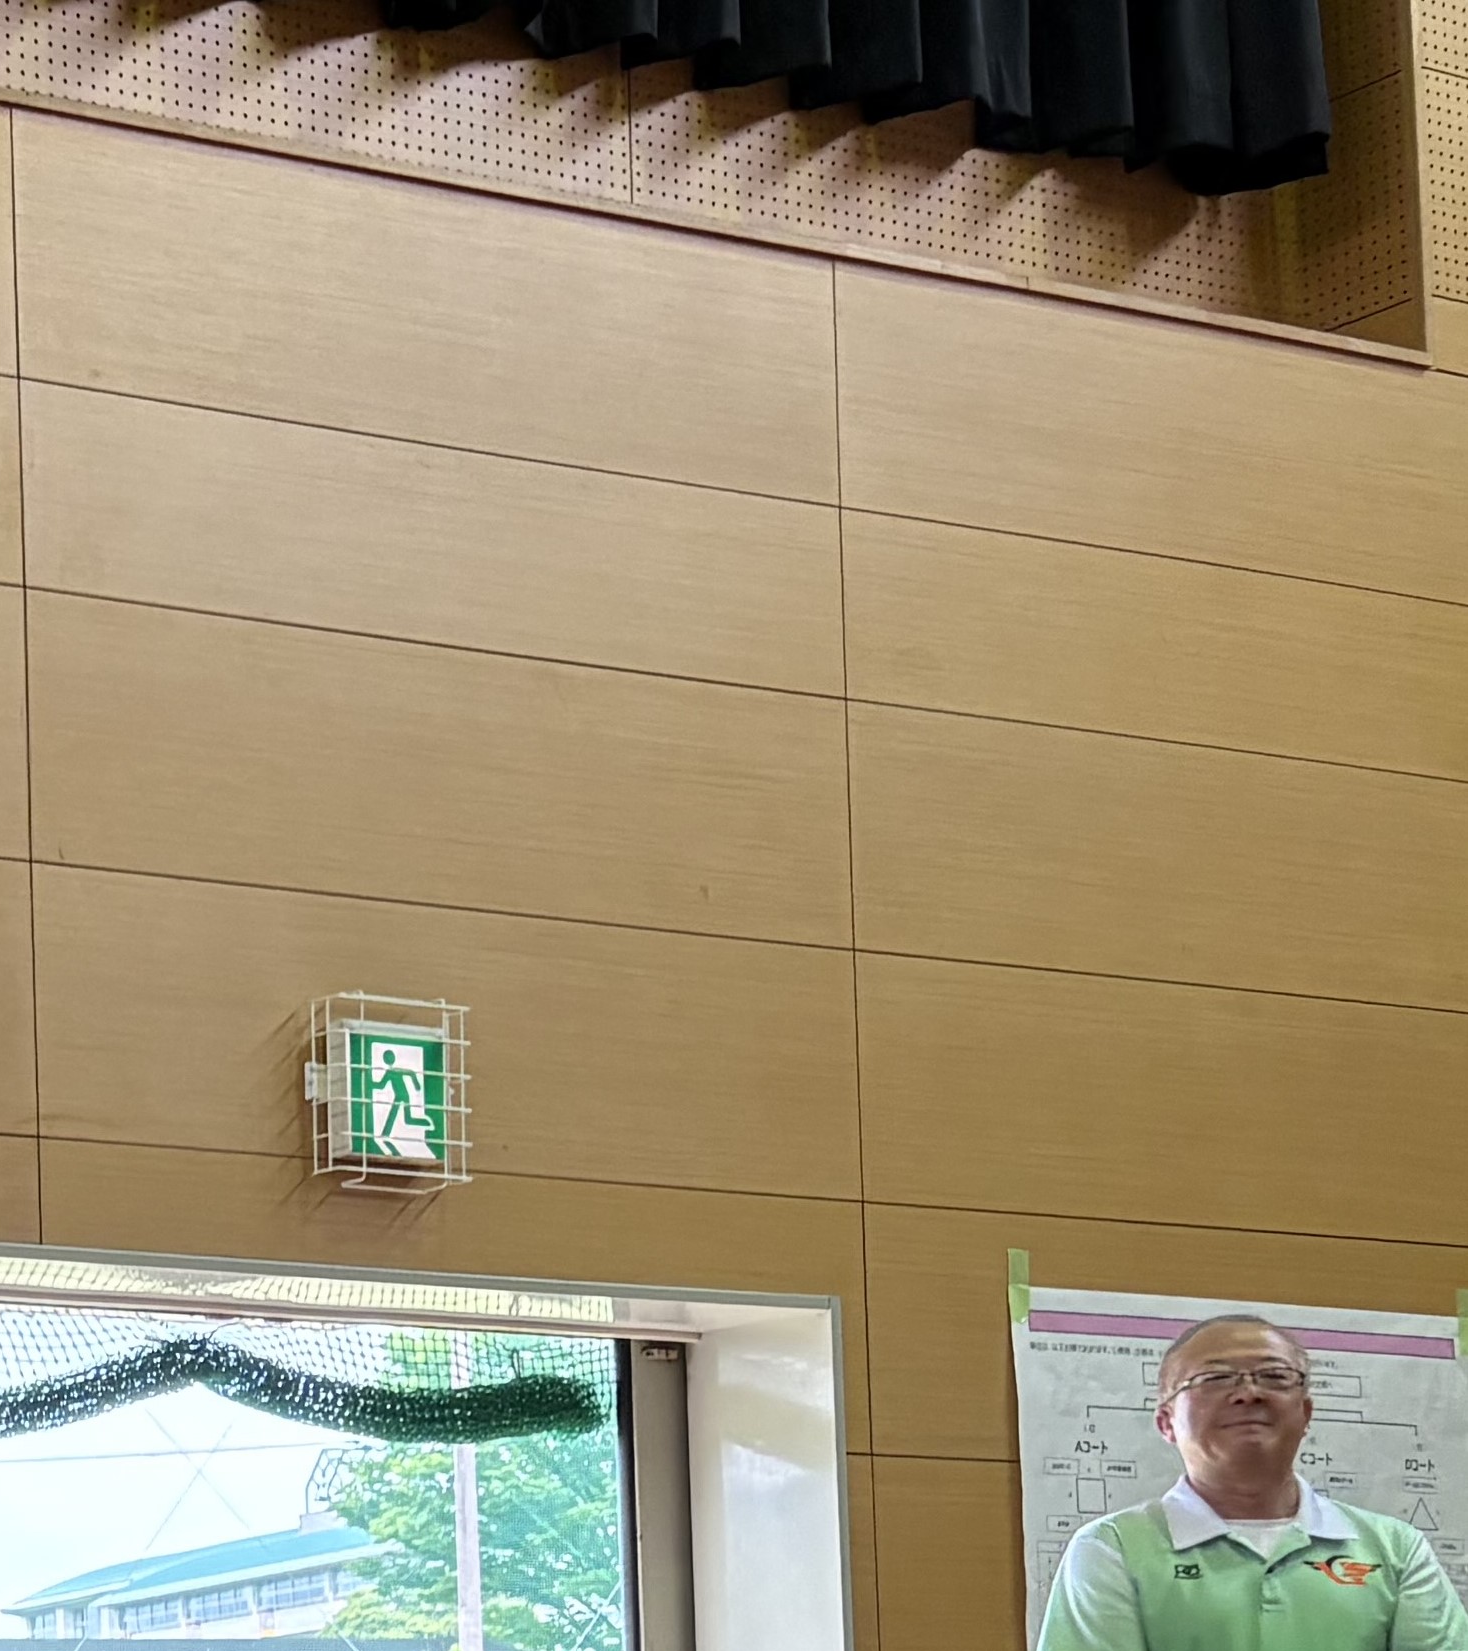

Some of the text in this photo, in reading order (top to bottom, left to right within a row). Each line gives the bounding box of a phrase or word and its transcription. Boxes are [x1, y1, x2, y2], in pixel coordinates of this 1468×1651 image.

[1074, 1439, 1109, 1456] Aコート
[1299, 1451, 1334, 1468] Cコート
